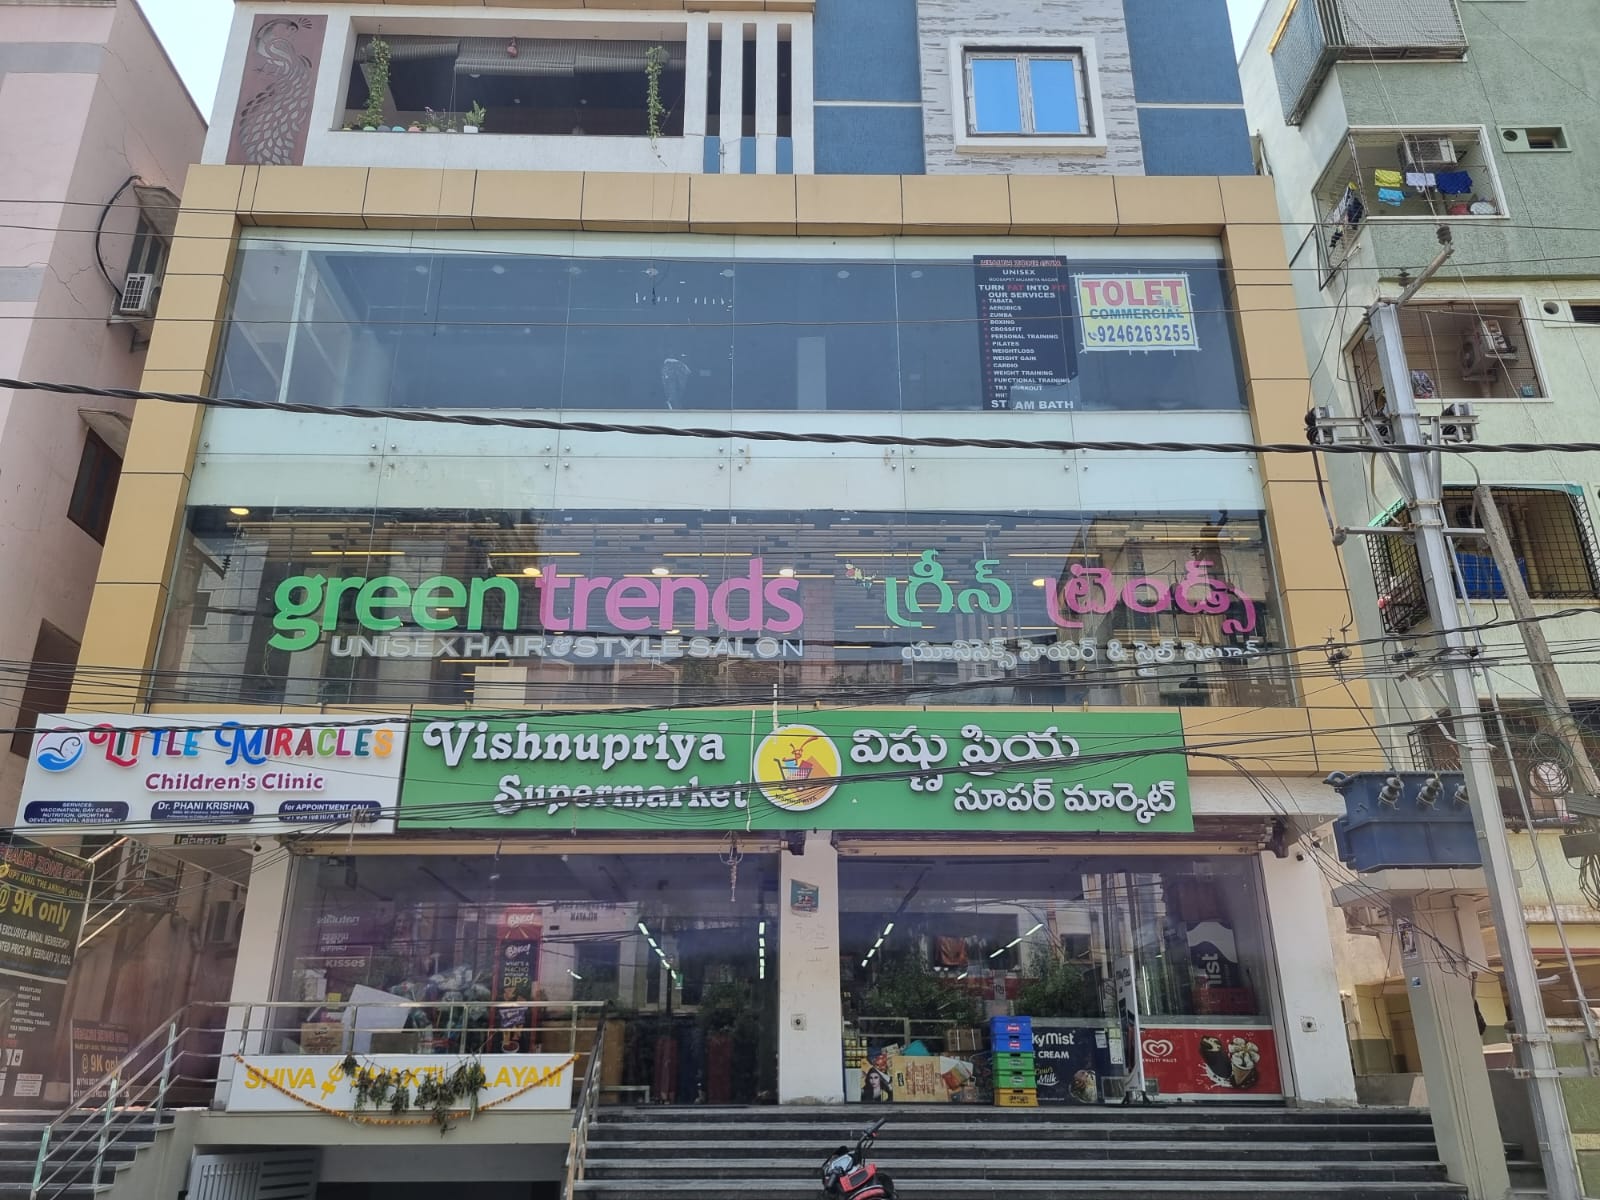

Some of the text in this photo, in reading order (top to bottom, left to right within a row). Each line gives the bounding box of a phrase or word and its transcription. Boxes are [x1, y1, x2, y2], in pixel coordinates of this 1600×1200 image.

[1089, 307, 1184, 320] COMMERCIAL
[1097, 324, 1190, 343] 9246263255
[1039, 400, 1074, 409] BATH
[885, 549, 1013, 627] గ్రీన్
[268, 557, 804, 651] green trends
[330, 635, 804, 658] UNISEX HAIR & STYLE SALON
[1107, 638, 1128, 661] &
[88, 720, 395, 767] LITTLE MIRACLES
[422, 720, 726, 772] Vishnupriya
[145, 771, 325, 793] Children's Clinic
[493, 774, 748, 815] Supermarket
[953, 778, 1177, 824] సూపర్ మార్కెట్
[158, 802, 249, 810] Dr. PHANI KRISHNA
[12, 888, 38, 918] 9K
[38, 901, 72, 933] only
[504, 977, 528, 986] DIP?
[1032, 1031, 1075, 1047] kyMist
[91, 1053, 104, 1072] 9K
[1038, 1051, 1070, 1059] CREAM
[244, 1065, 317, 1089] SHIVA
[464, 1065, 564, 1088] LAYAM
[1037, 1074, 1057, 1084] Milk
